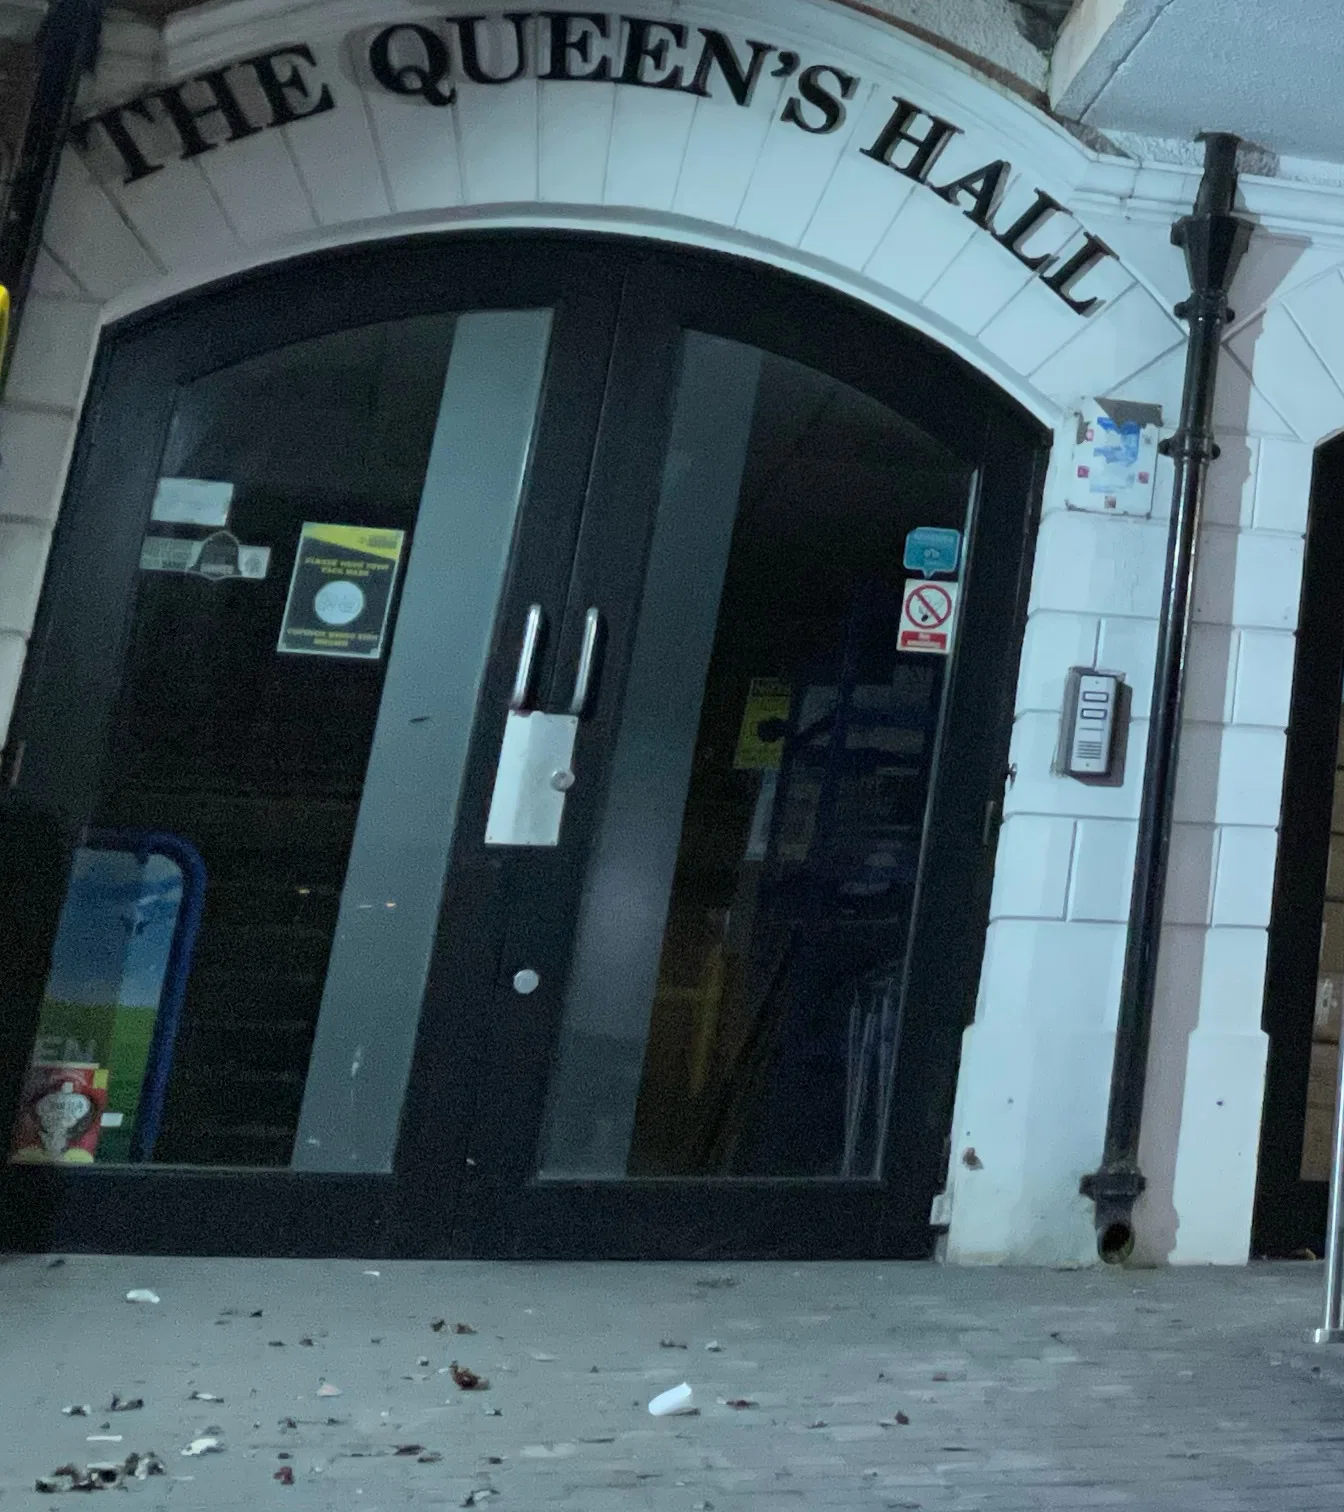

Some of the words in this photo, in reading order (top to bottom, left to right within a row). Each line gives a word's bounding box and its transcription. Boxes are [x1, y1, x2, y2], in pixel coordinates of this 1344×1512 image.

[70, 42, 337, 185] THE
[368, 10, 860, 135] QUEEN'S
[858, 95, 1121, 318] HALL
